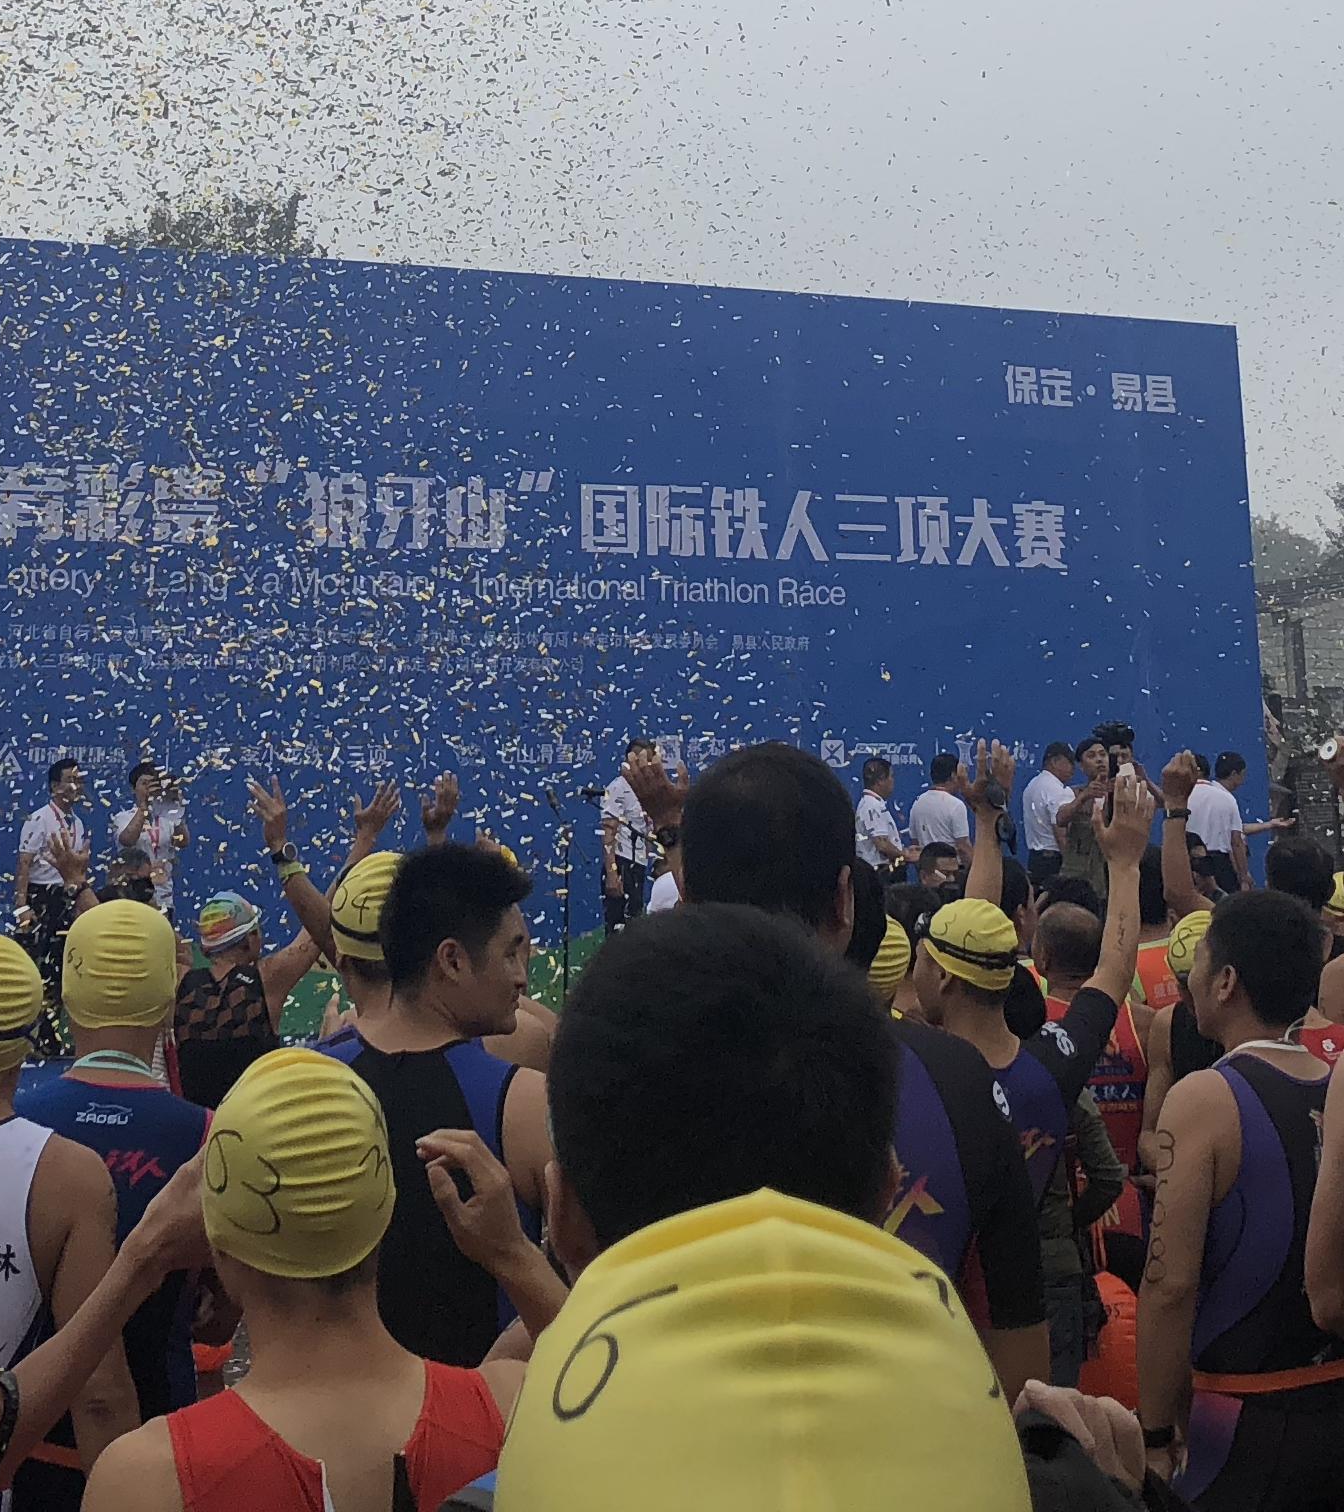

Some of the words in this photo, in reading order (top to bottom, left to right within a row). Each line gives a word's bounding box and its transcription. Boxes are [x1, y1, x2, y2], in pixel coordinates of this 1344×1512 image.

[1004, 364, 1177, 414] 保定·易县
[658, 574, 769, 606] Triathlon
[778, 578, 847, 607] Race
